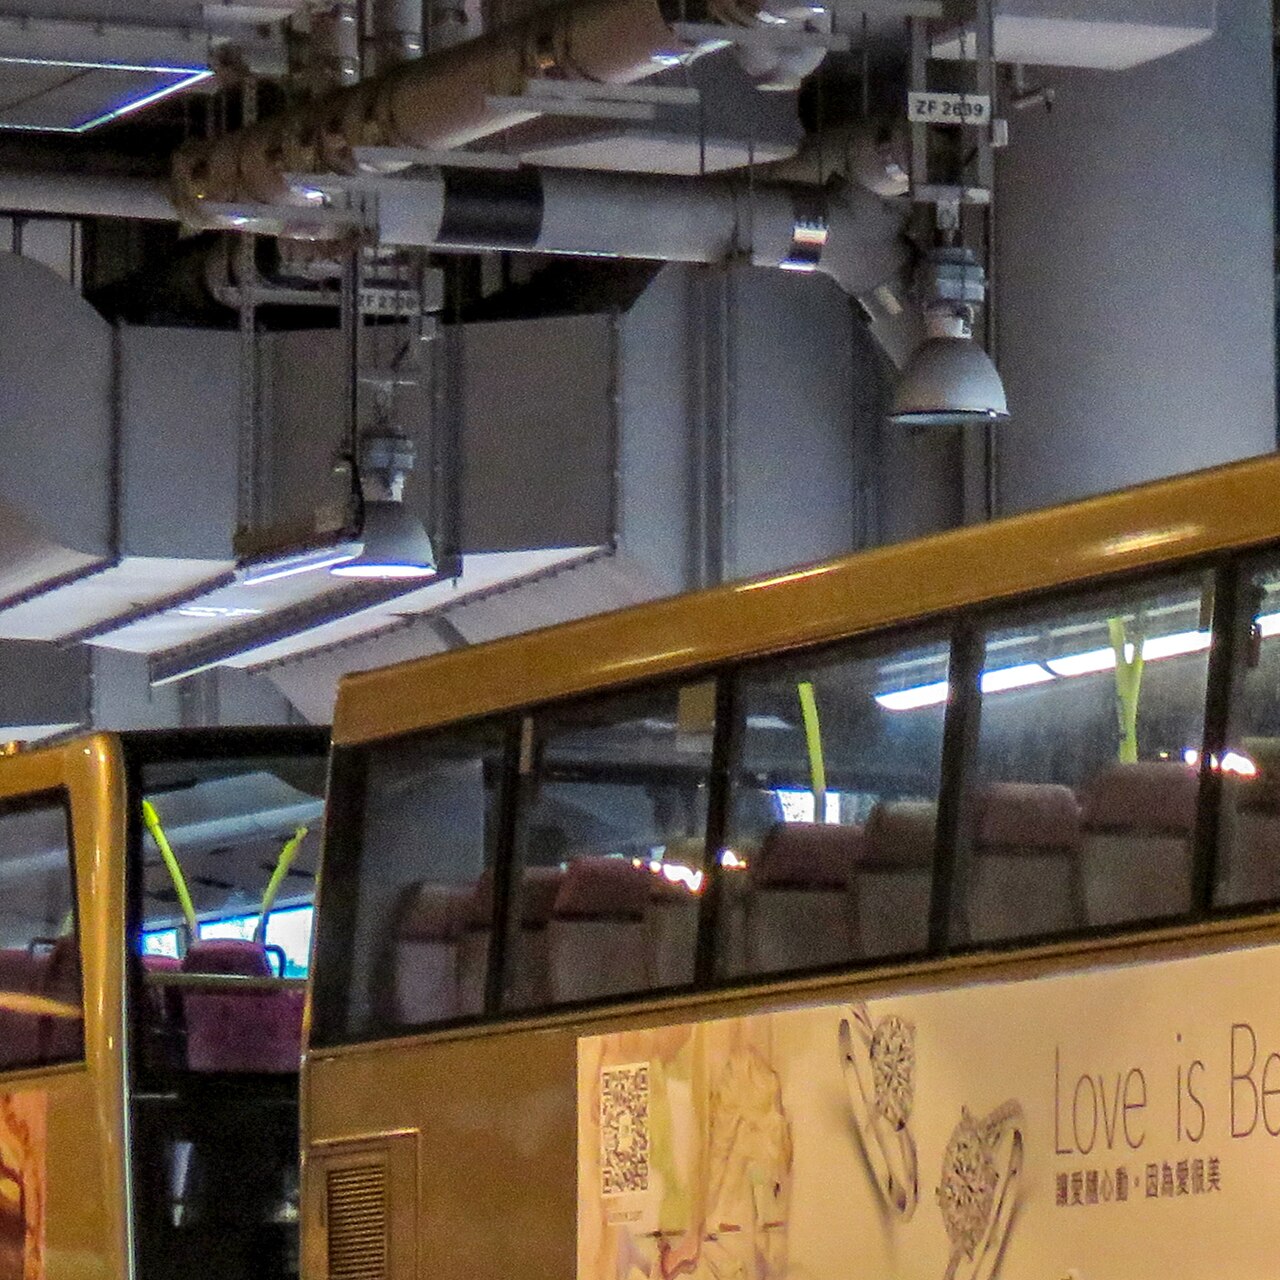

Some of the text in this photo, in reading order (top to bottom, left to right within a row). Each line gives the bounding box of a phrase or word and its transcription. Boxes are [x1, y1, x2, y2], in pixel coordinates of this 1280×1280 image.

[915, 99, 936, 115] ZF
[1054, 1044, 1148, 1156] Love
[1175, 1032, 1207, 1143] is
